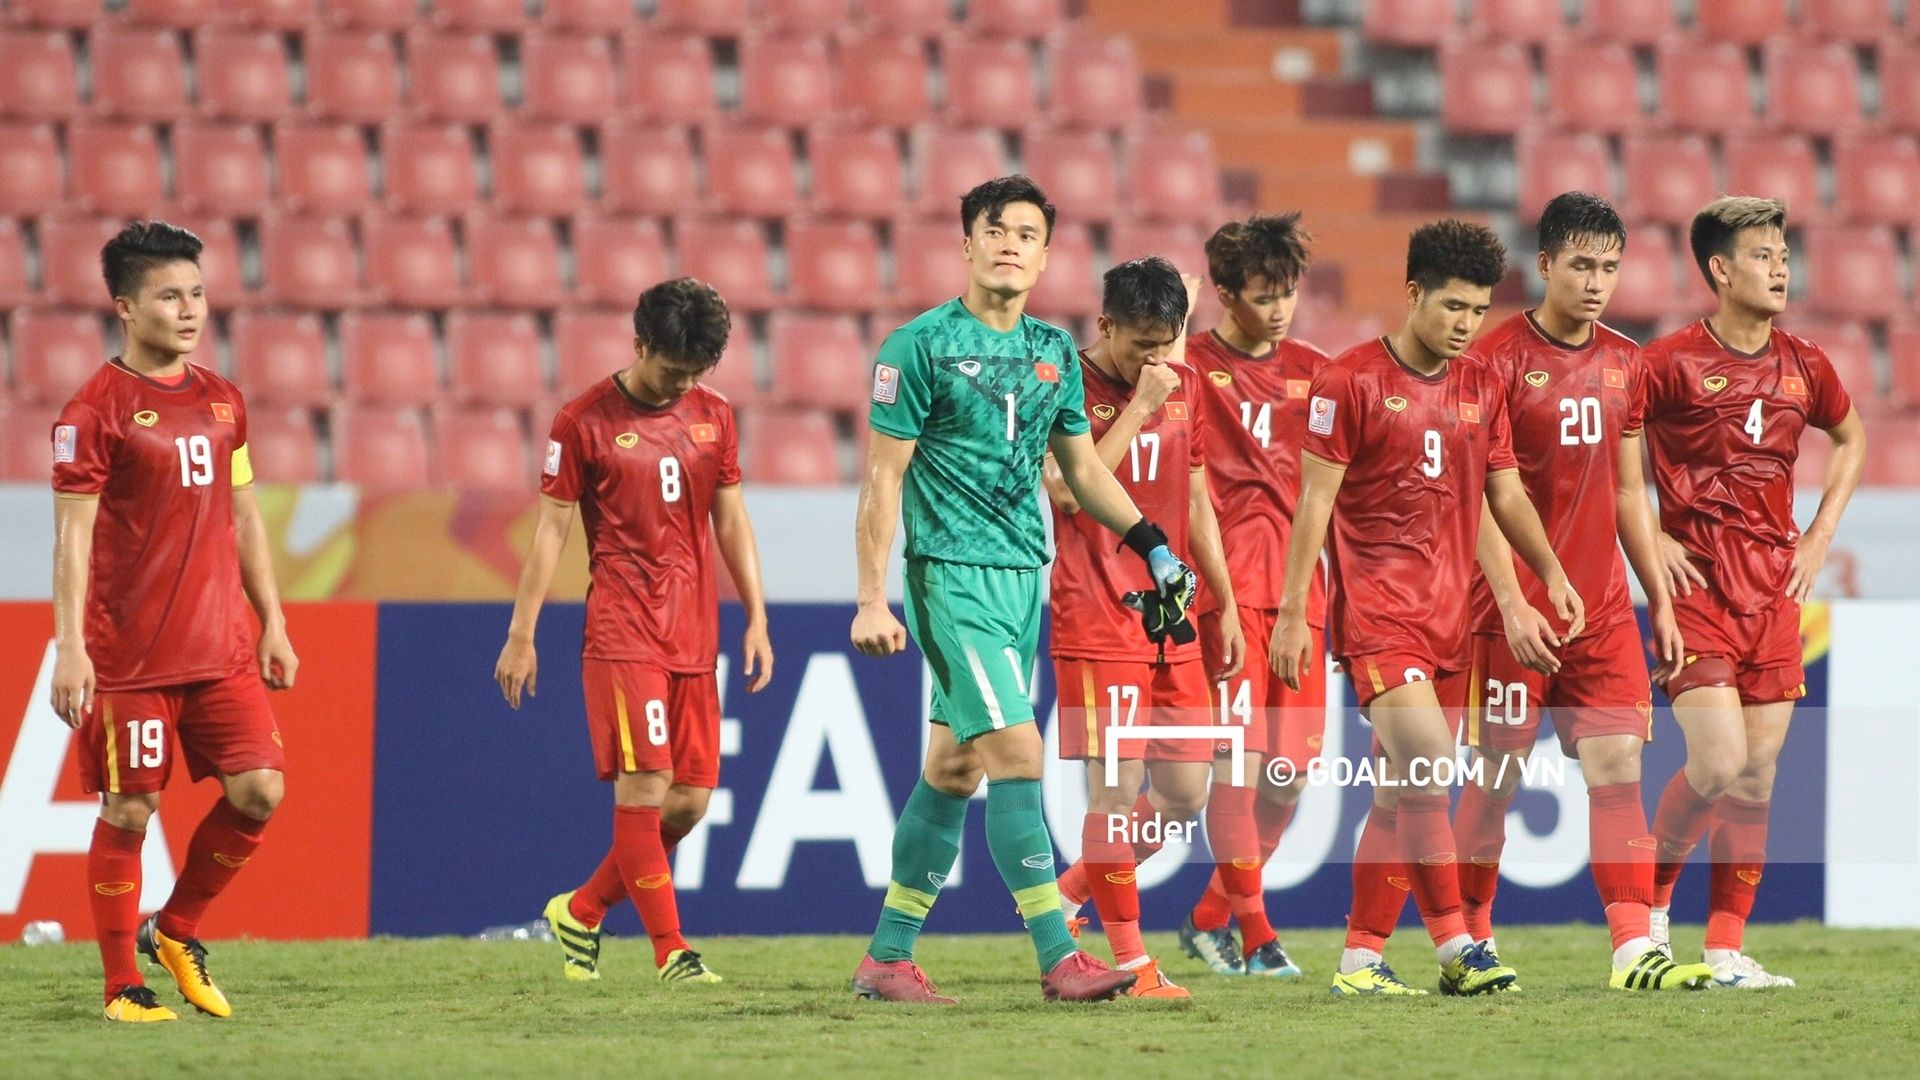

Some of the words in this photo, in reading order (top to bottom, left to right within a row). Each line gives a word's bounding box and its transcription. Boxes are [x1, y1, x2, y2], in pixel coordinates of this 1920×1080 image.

[1004, 393, 1016, 441] 1
[1239, 401, 1271, 449] 14
[1559, 396, 1603, 446] 20
[1745, 398, 1763, 445] 4
[175, 434, 214, 487] 19
[1129, 432, 1161, 482] 17
[1423, 429, 1442, 478] 9
[659, 456, 681, 503] 8
[1003, 647, 1026, 695] 1
[645, 699, 668, 746] 8
[1106, 685, 1139, 727] 17
[1217, 679, 1253, 725] 14
[1486, 678, 1528, 726] 20
[127, 719, 164, 769] 19
